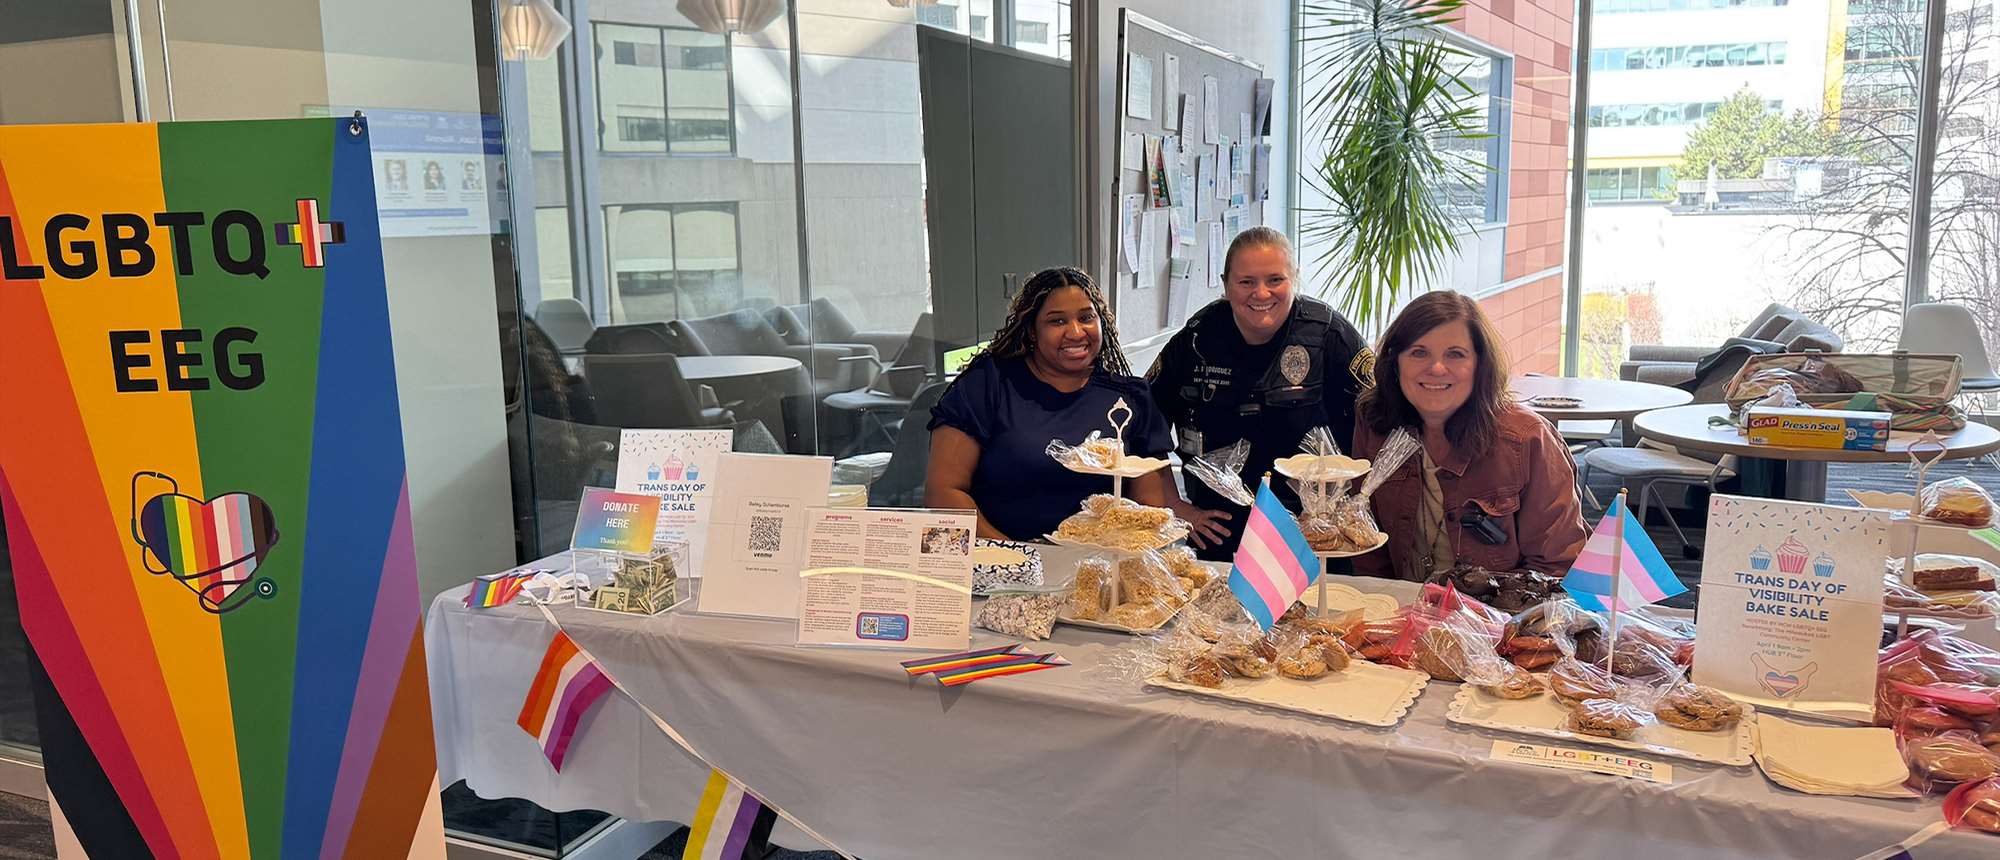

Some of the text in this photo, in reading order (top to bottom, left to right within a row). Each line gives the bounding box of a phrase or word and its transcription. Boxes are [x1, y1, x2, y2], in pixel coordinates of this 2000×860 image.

[109, 326, 266, 393] EEG
[1819, 422, 1841, 432] Seal
[637, 483, 707, 492] TRANS DAY OF
[602, 501, 640, 513] DONATE
[671, 503, 696, 511] SALE
[606, 517, 631, 529] HERE
[1734, 572, 1848, 595] TRANS DAY OF
[618, 591, 625, 605] 20
[1749, 588, 1825, 606] VISIBILITY
[1745, 601, 1830, 622] BAKE SALE
